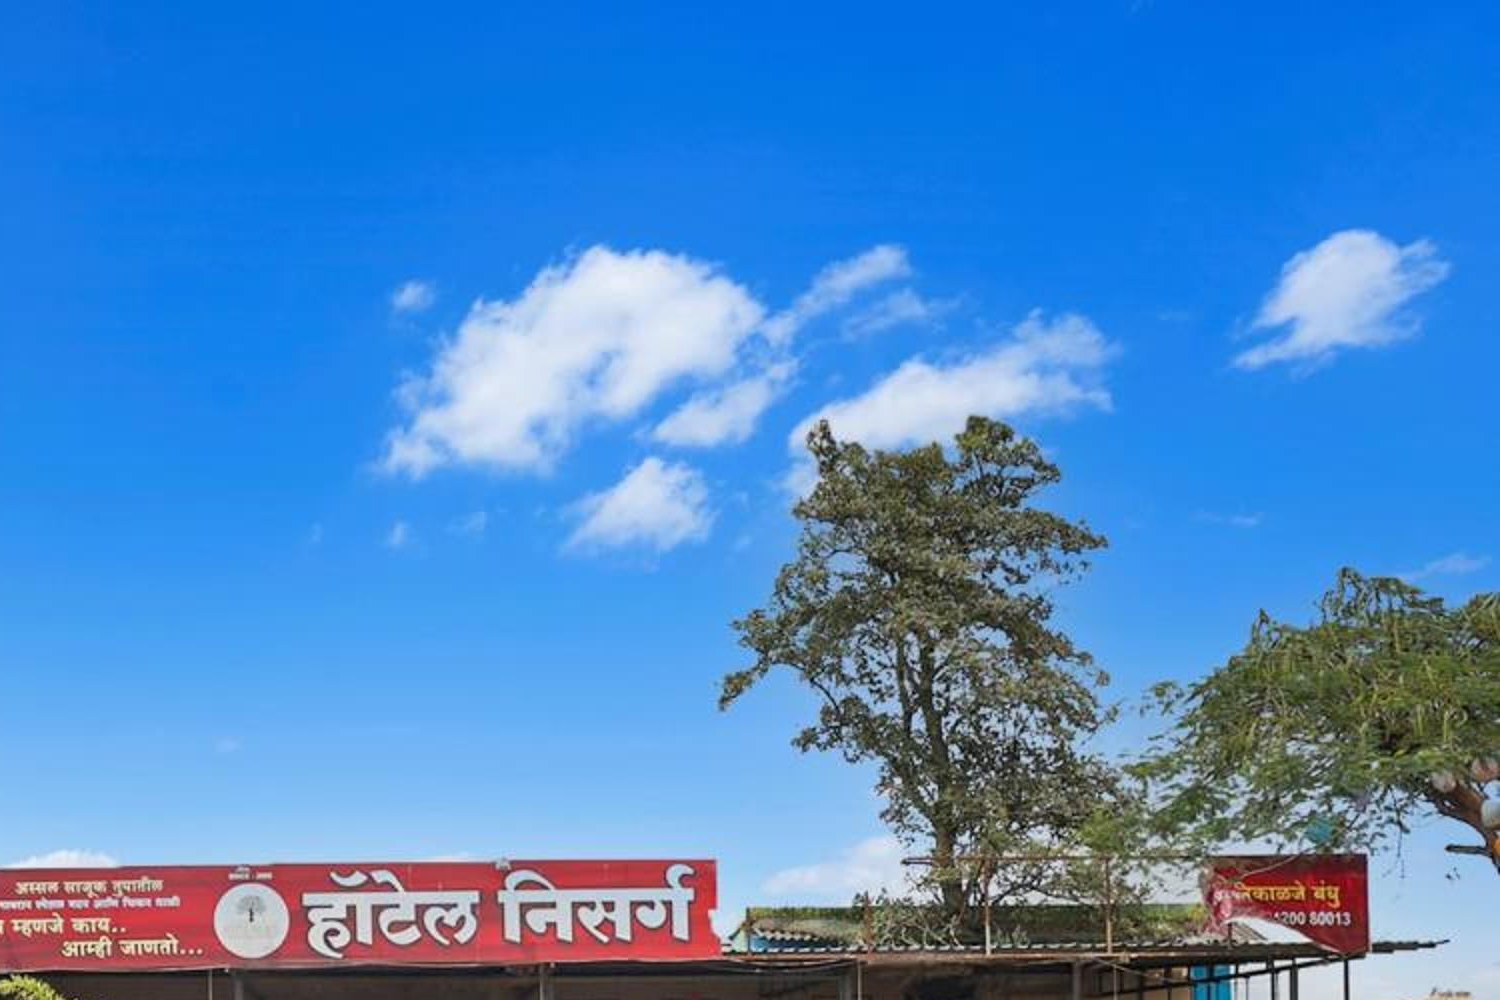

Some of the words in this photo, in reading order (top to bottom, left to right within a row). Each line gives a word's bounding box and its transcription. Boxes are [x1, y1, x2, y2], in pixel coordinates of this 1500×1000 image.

[301, 869, 480, 959] हॉटेल
[497, 864, 695, 944] निसर्ग
[11, 912, 64, 938] म्हणजे
[61, 935, 112, 958] आम्ही
